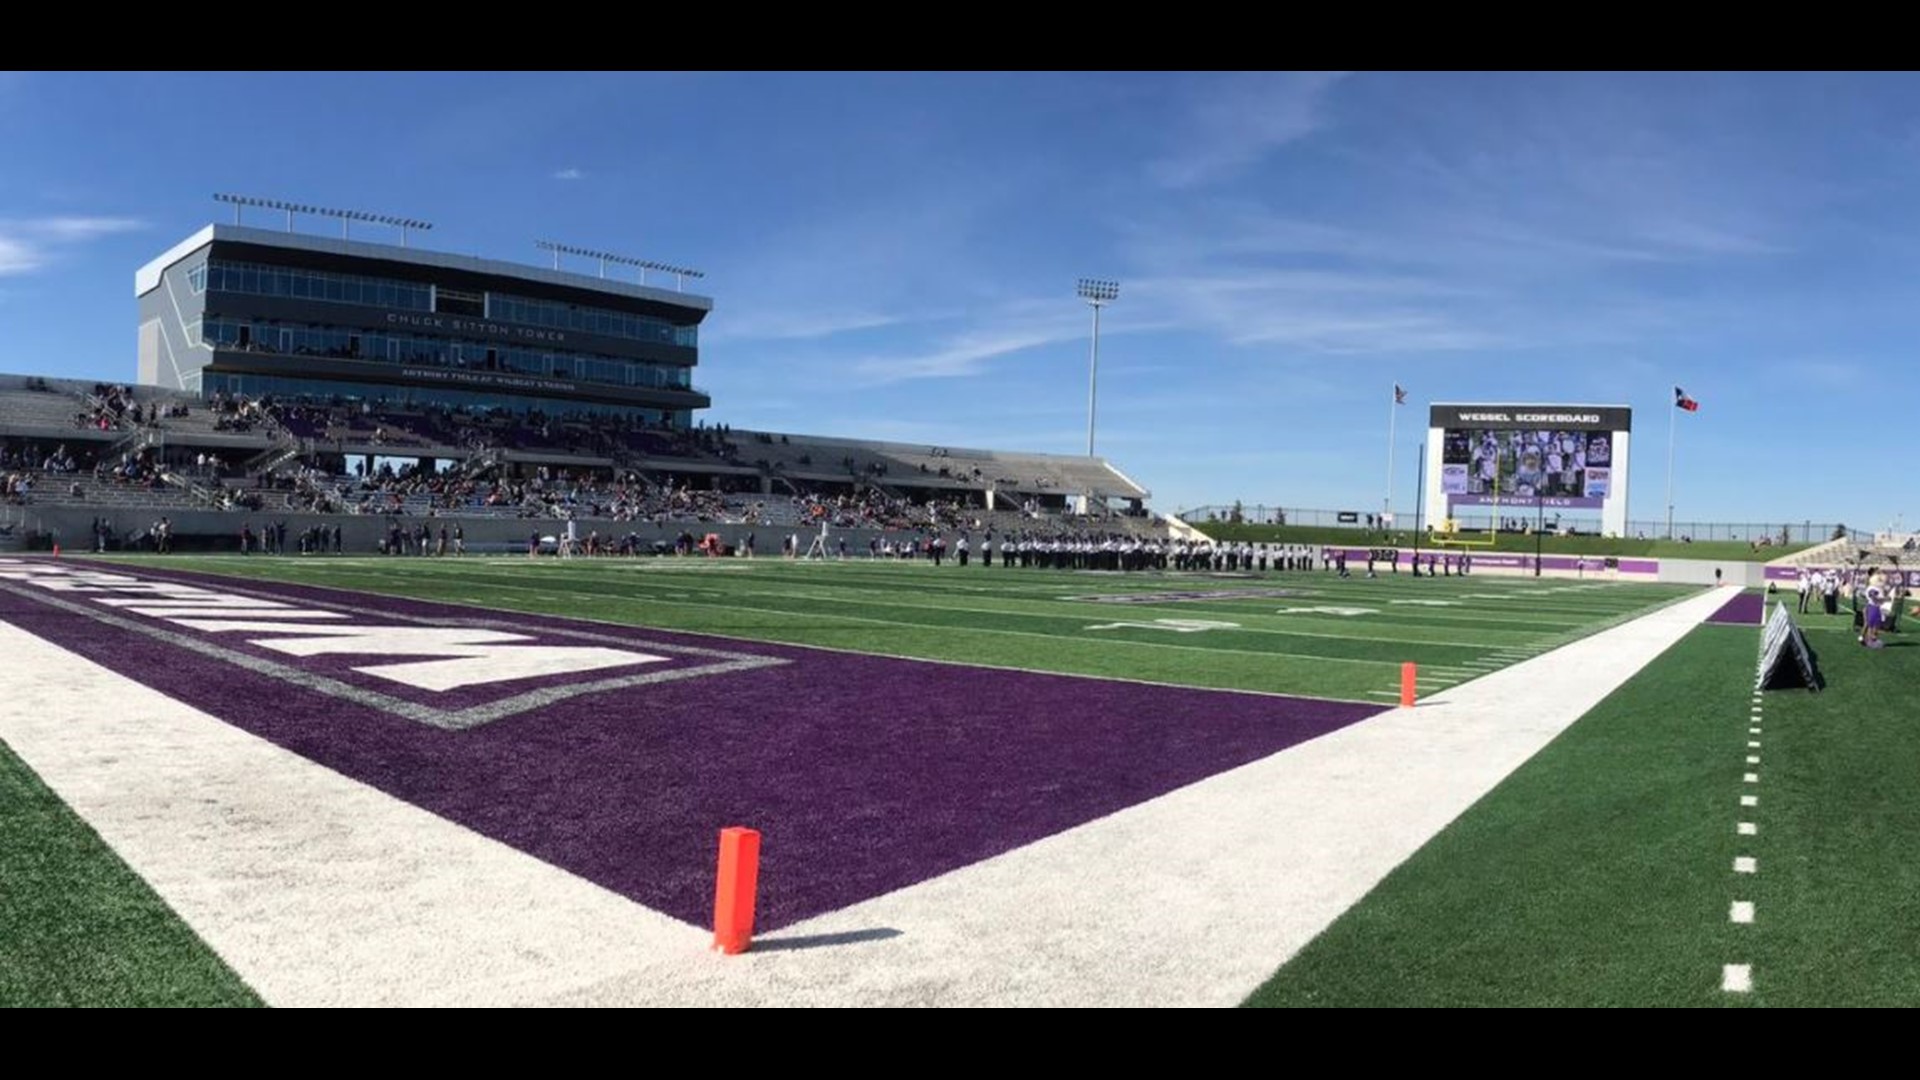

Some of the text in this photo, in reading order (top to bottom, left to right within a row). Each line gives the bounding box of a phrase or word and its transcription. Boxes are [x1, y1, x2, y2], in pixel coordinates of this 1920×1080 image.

[387, 313, 565, 341] CHUCK SITTON TOWER
[1459, 412, 1600, 423] WESSEL SCOREBOARD
